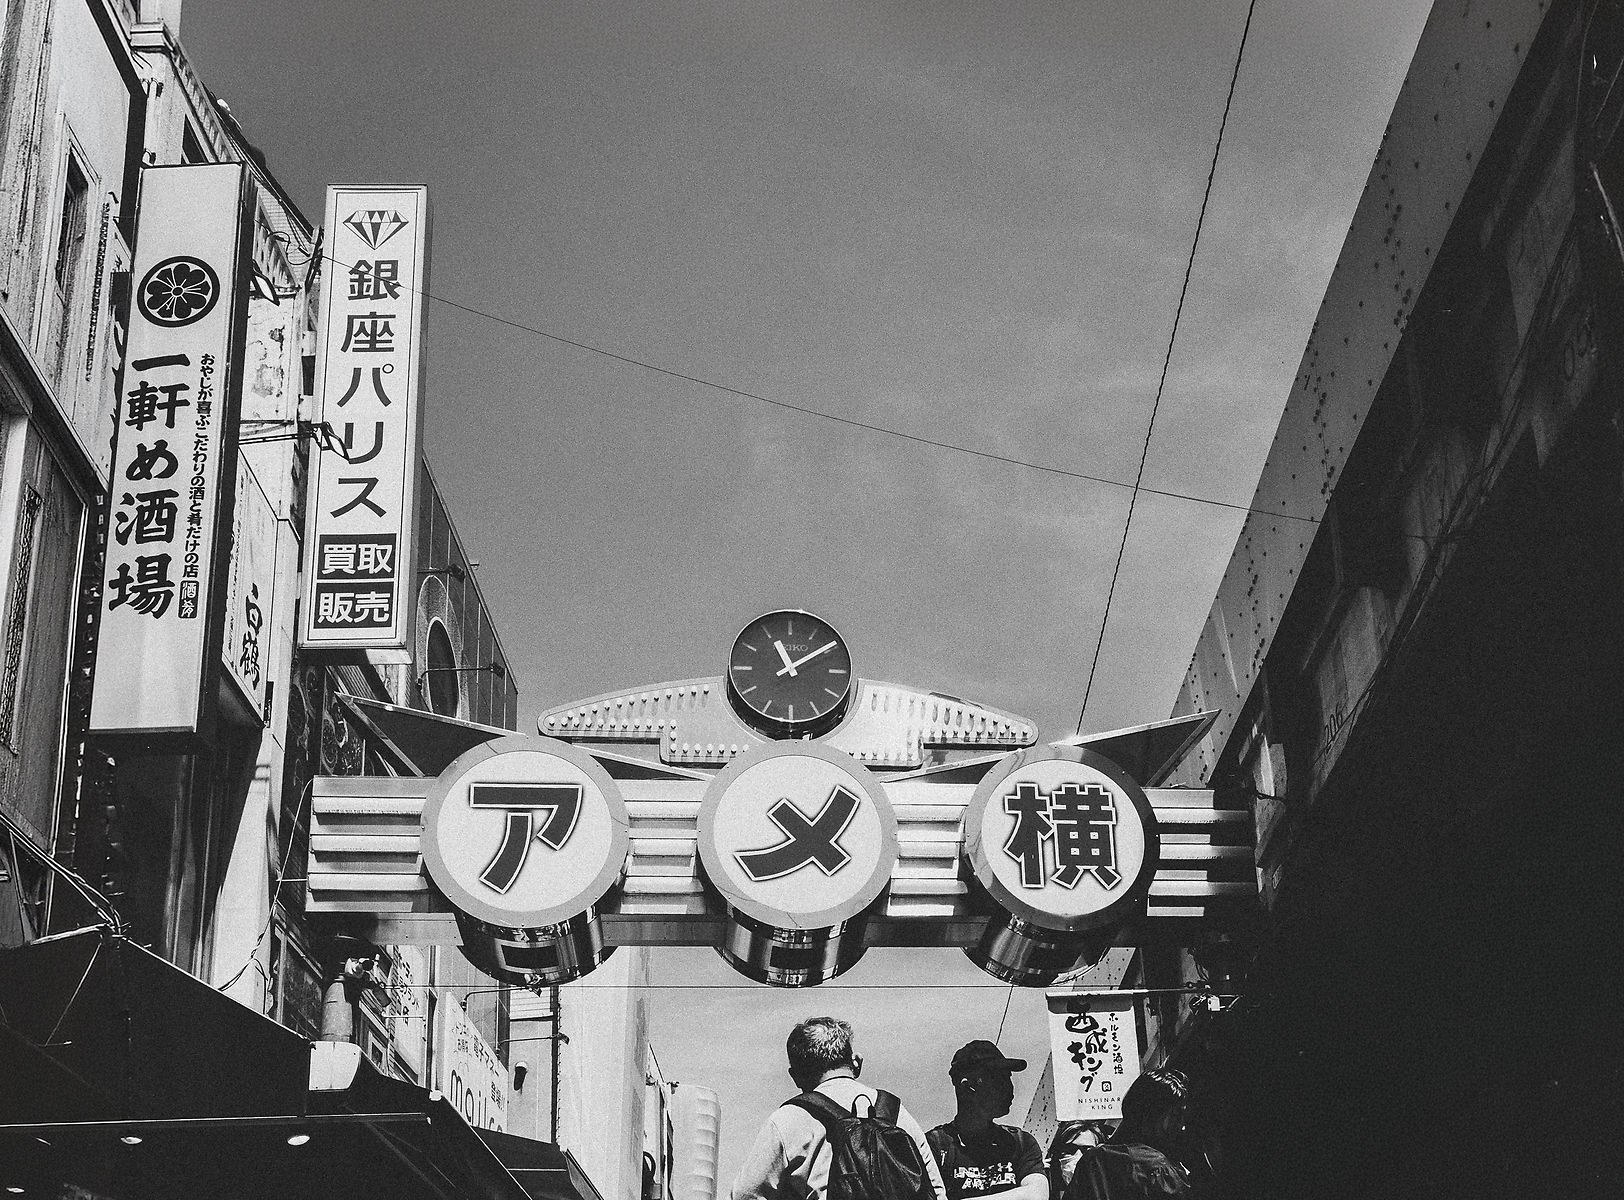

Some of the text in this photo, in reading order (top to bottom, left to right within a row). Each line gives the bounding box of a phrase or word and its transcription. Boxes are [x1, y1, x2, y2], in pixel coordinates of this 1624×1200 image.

[330, 258, 401, 518] 銀座パリス
[108, 353, 191, 619] 一軒め酒場
[182, 353, 215, 579] おやじが喜ぶこだわりの酒と肴だけの店
[321, 543, 393, 574] 買取
[317, 591, 392, 624] 販売
[783, 644, 809, 652] EIKO
[469, 782, 1122, 894] アメ横
[1078, 1096, 1121, 1104] NISHINAR
